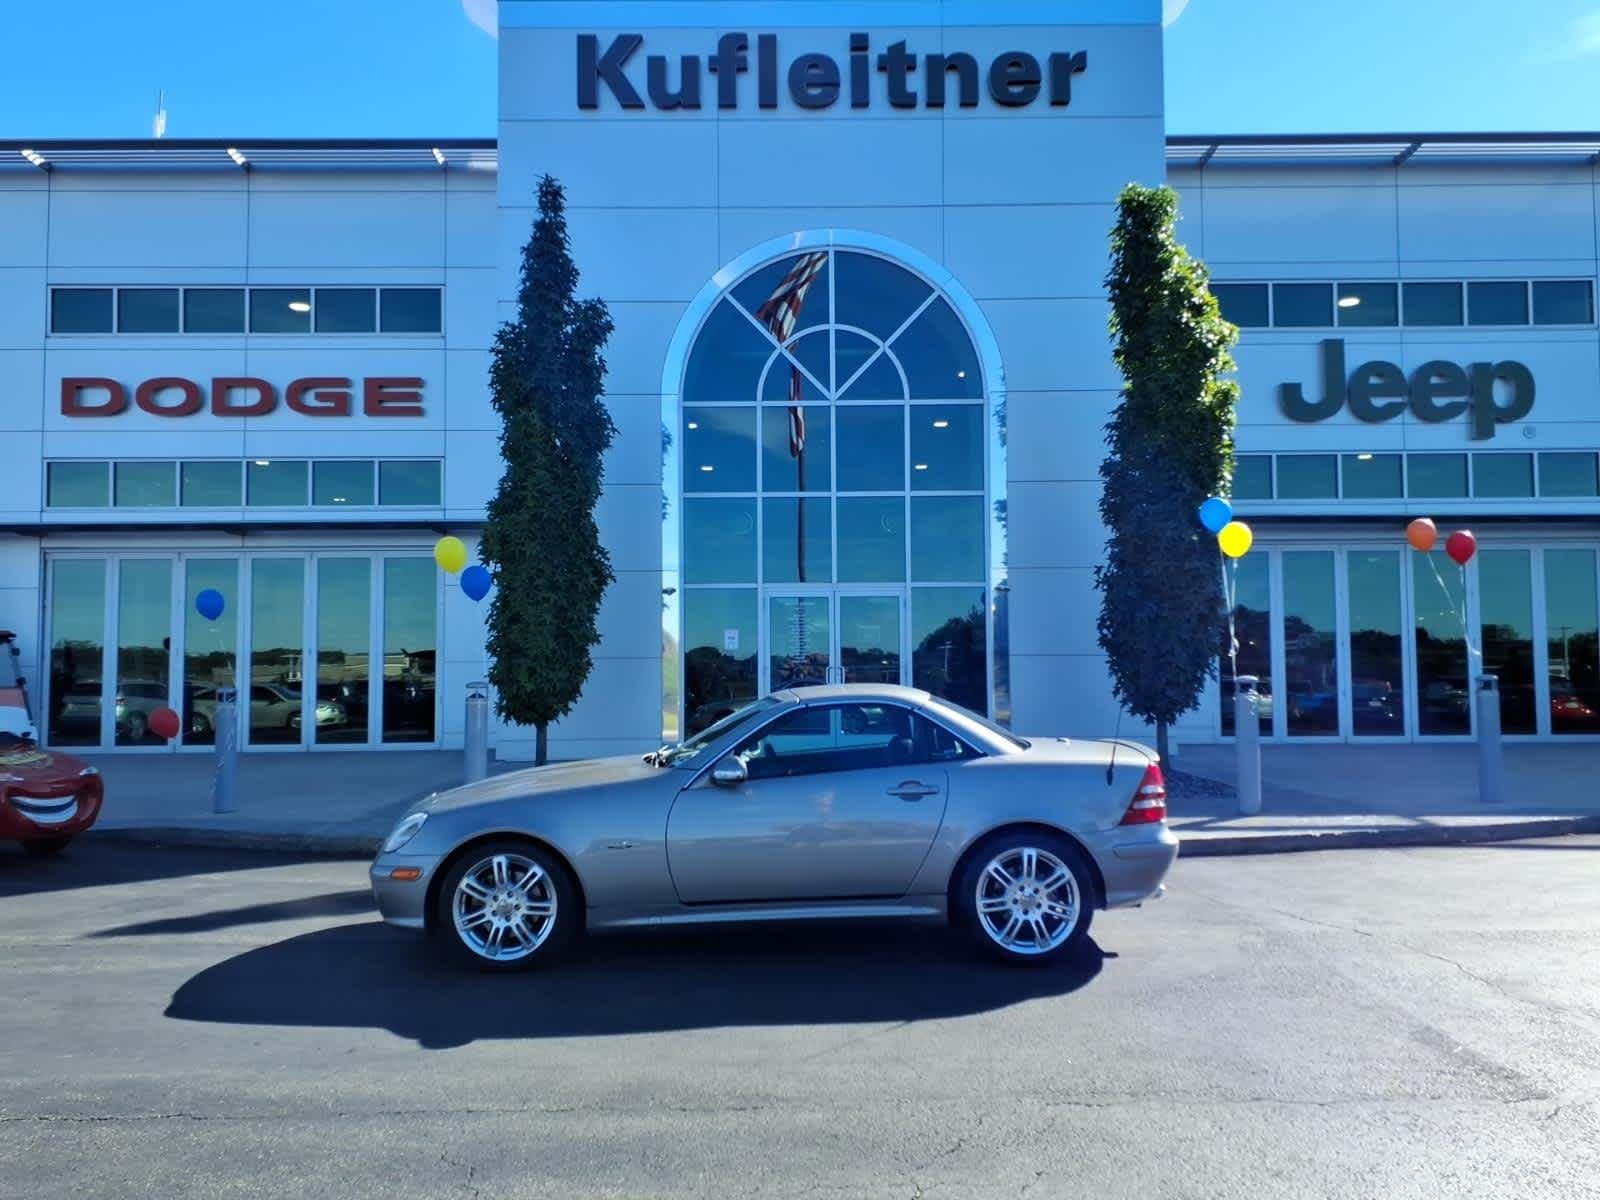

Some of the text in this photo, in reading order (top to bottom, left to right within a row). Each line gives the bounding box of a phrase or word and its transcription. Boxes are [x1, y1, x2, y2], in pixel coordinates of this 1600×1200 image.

[576, 32, 1088, 111] Kufleitner
[61, 377, 425, 417] DODGE
[1278, 338, 1536, 441] Jeep
